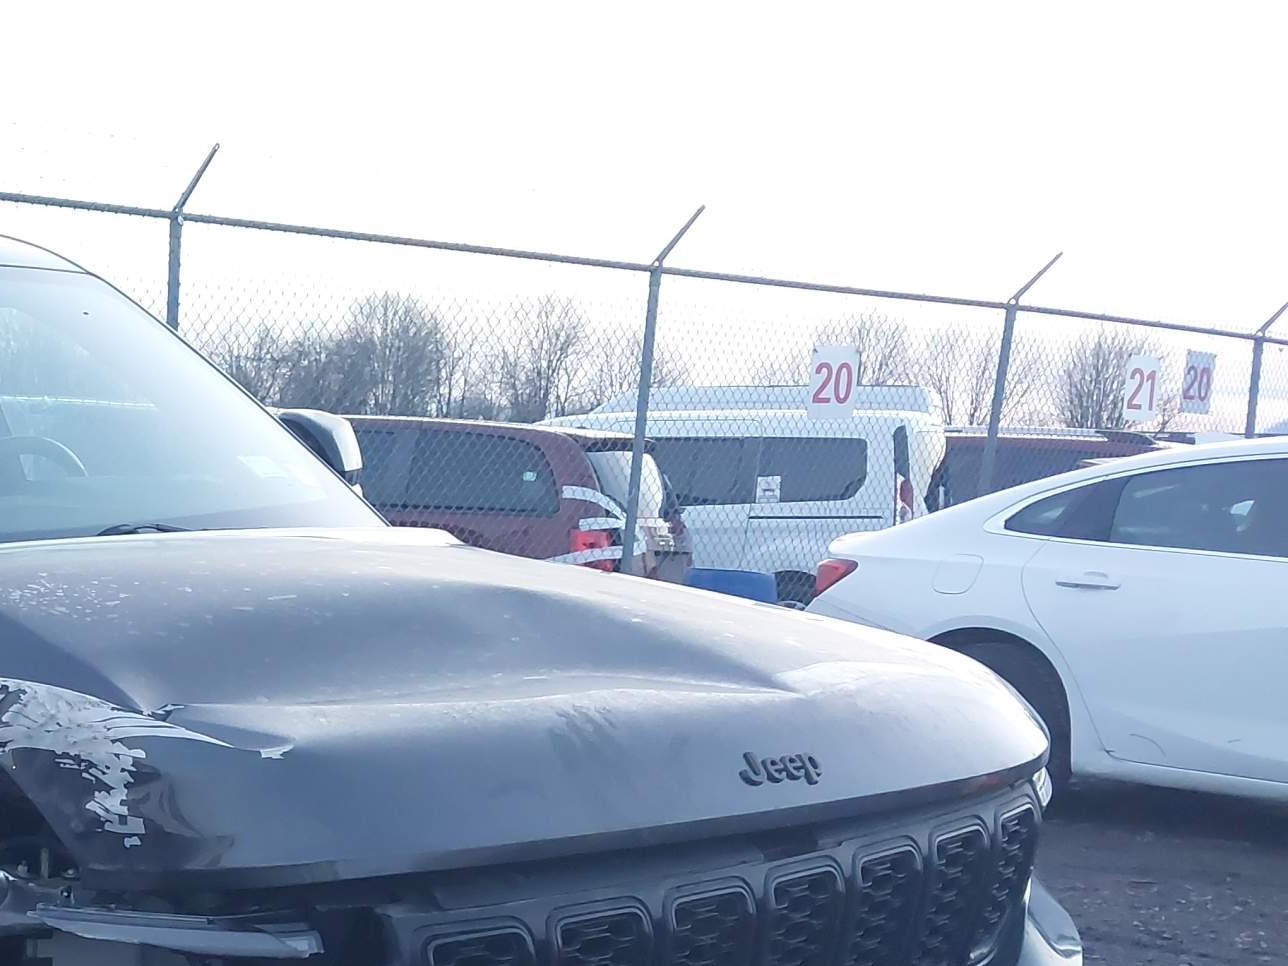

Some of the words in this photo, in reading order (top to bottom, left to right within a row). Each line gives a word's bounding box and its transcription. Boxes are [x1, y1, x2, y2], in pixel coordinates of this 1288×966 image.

[812, 362, 853, 404] 20
[1127, 367, 1157, 411] 21
[1183, 365, 1212, 402] 20
[738, 751, 822, 787] Jeep
